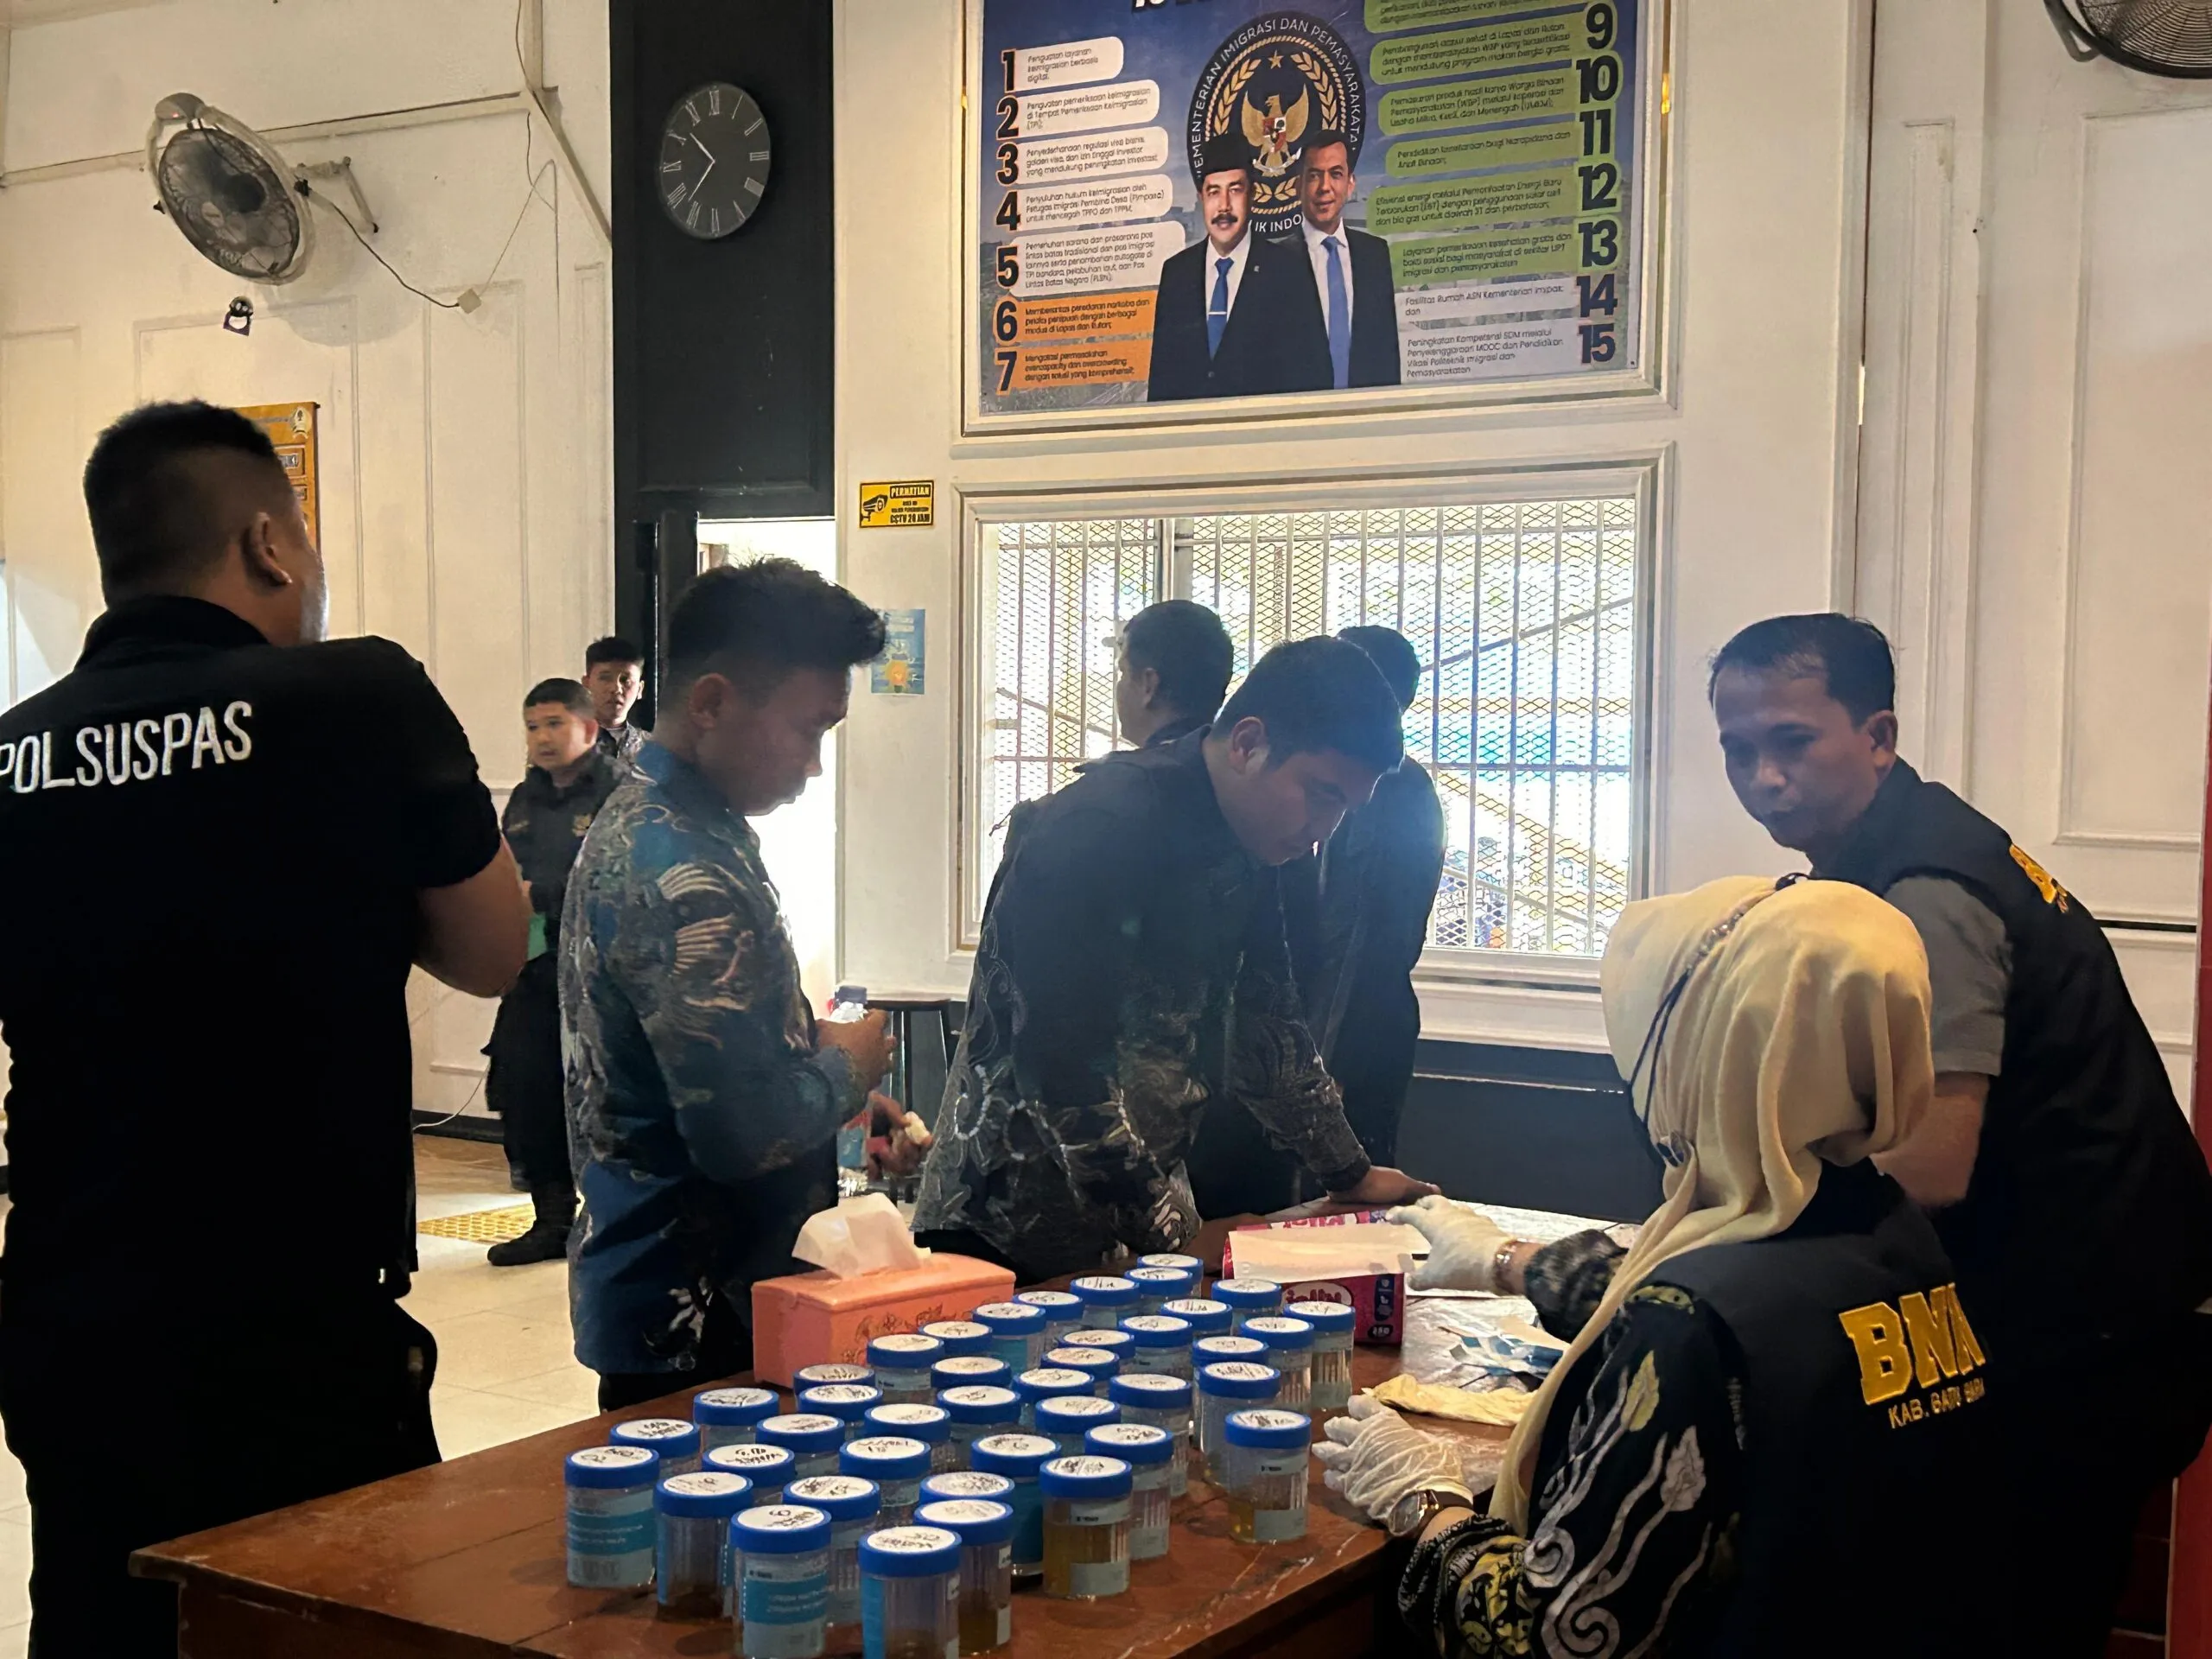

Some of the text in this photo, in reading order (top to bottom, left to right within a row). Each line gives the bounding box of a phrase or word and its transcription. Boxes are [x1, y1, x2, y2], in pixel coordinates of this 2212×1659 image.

[1221, 19, 1276, 63] IMIGRASI
[1280, 17, 1308, 33] DAN
[1586, 3, 1612, 49] 9
[1002, 52, 1014, 91] 1
[1576, 55, 1618, 104] 10
[997, 98, 1019, 138] 2
[1580, 109, 1611, 156] 11
[997, 143, 1019, 184] 3
[1578, 162, 1618, 211] 12
[996, 191, 1020, 230] 4
[1578, 219, 1618, 267] 13
[997, 247, 1019, 287] 5
[1576, 274, 1618, 318] 14
[997, 301, 1018, 340] 6
[1578, 323, 1617, 363] 15
[997, 352, 1017, 391] 7
